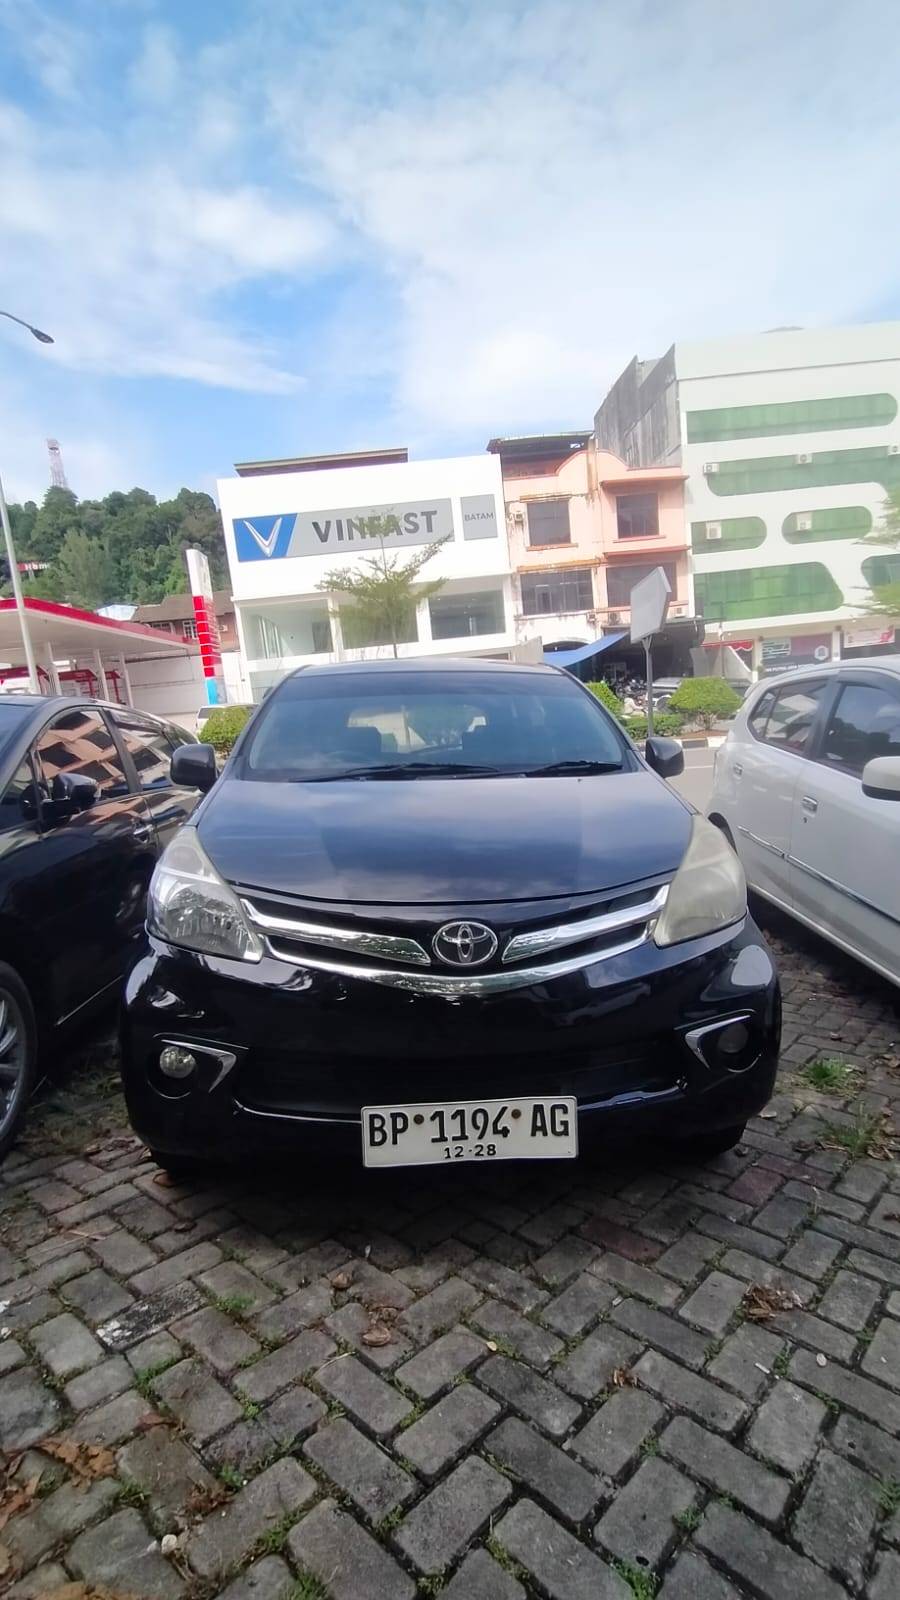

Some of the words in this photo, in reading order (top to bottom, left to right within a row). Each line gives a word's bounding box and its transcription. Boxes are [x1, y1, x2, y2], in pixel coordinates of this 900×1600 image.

[464, 512, 494, 522] BATAM
[369, 1112, 409, 1147] BP
[430, 1106, 511, 1143] 1194
[530, 1103, 570, 1137] AG
